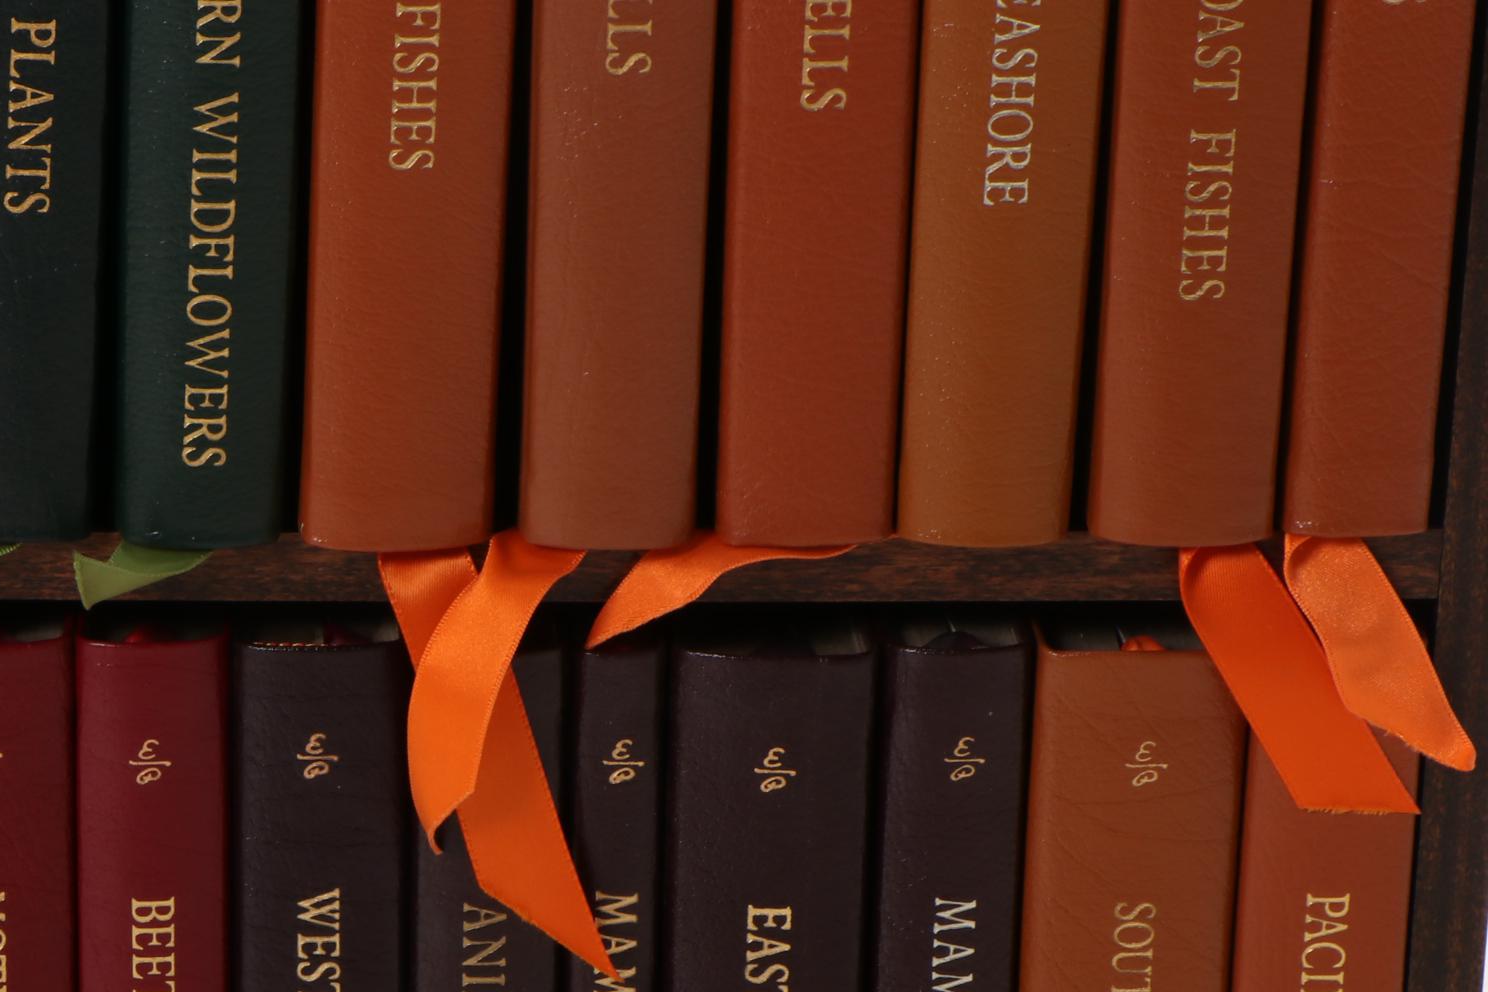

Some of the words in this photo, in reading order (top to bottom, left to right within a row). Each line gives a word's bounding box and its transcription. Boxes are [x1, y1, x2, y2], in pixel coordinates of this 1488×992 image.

[3, 17, 57, 214] PLANTS
[194, 0, 242, 68] RN
[388, 2, 441, 170] FISHES
[799, 0, 853, 112] ELLS
[181, 92, 239, 467] WILDFLOWERS
[1178, 128, 1237, 301] FISHES
